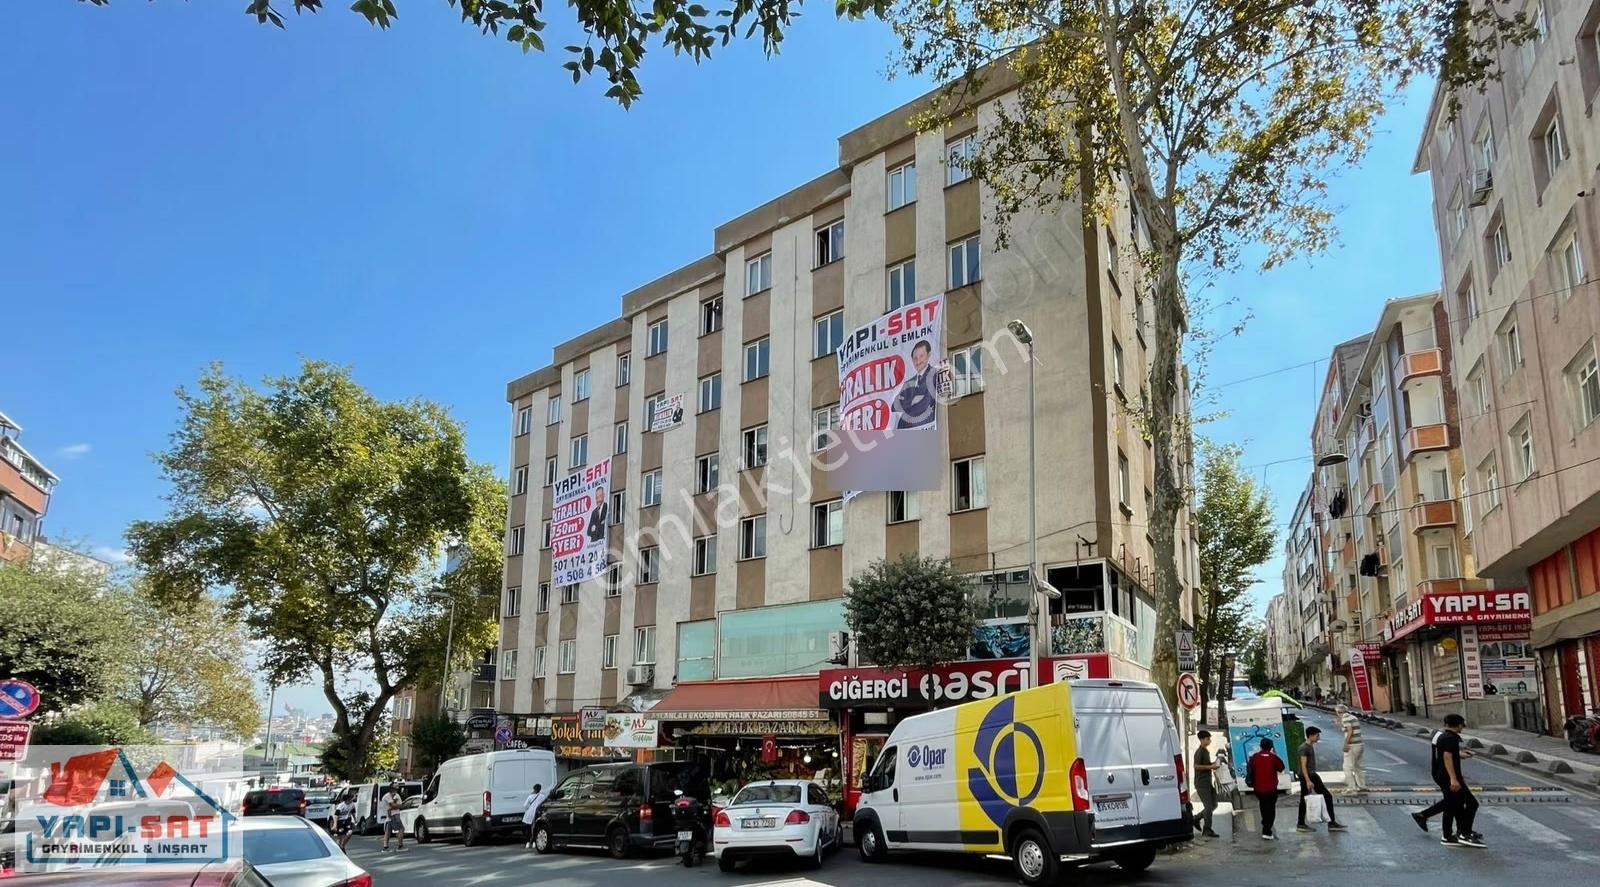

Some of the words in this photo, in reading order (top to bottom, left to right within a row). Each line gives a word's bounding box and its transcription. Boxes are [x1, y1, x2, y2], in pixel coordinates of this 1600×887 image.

[839, 299, 940, 363] YAPI-SAT
[901, 324, 933, 343] EMLAK
[555, 459, 610, 496] YAPI-SAT
[1429, 592, 1530, 613] YAPI-SA
[829, 673, 908, 701] CİĞERCİ
[551, 720, 584, 742] Sokak
[724, 721, 754, 734] HALK
[758, 721, 801, 734] PAZARI
[923, 745, 947, 770] Opar
